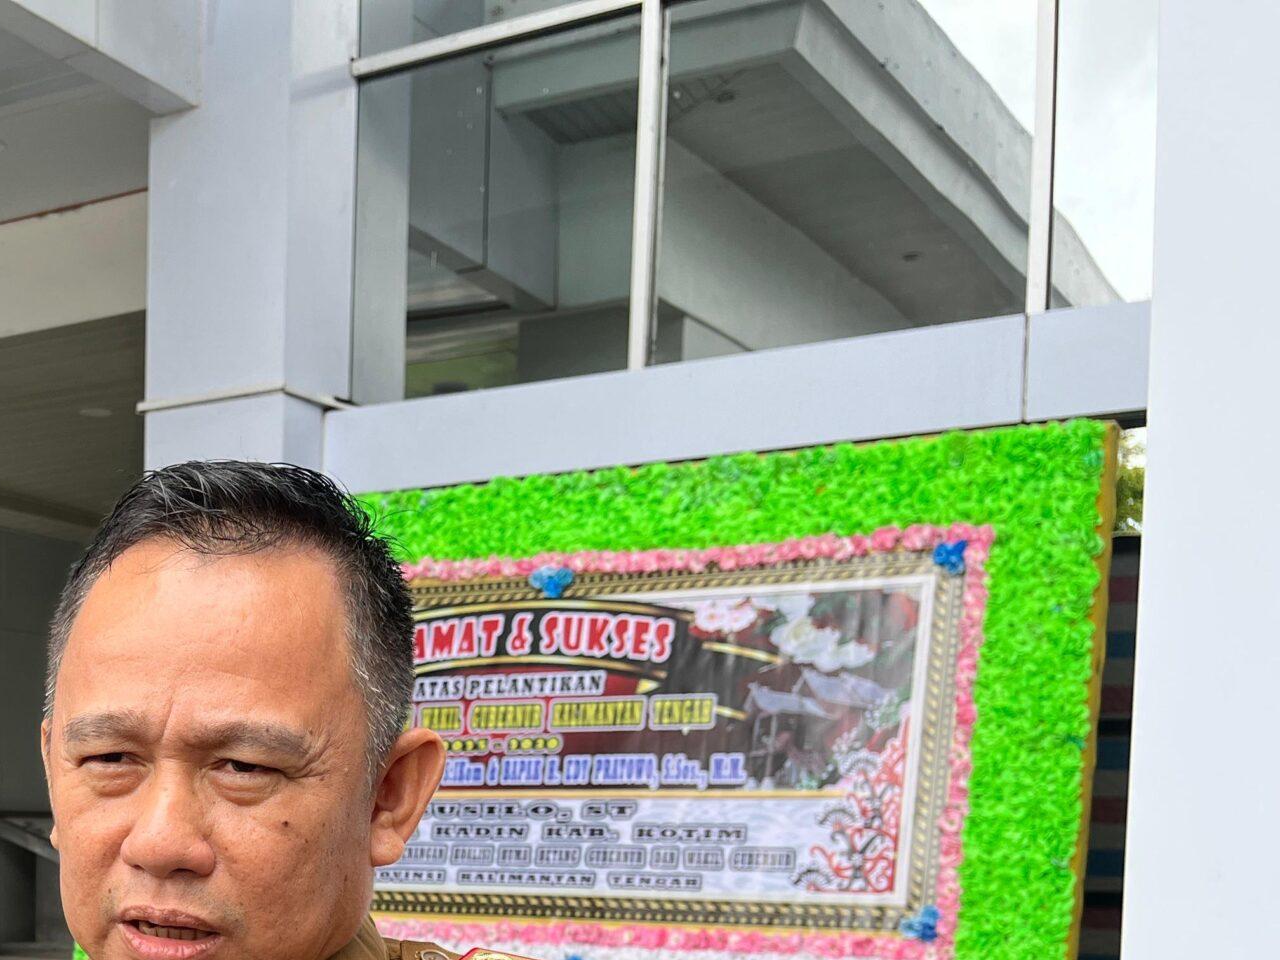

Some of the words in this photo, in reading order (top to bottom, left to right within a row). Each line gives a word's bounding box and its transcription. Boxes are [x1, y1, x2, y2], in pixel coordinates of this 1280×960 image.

[510, 616, 529, 651] &
[543, 616, 671, 659] SUKSES
[415, 680, 461, 698] ATAS
[469, 674, 602, 696] PELANTIKAN
[471, 704, 542, 729] GUBERNUR
[551, 700, 644, 727] KALIMANTAN
[654, 698, 713, 725] TENGAH
[425, 804, 569, 820] USILO,
[587, 804, 633, 816] ST
[435, 826, 525, 837] KADIN
[547, 826, 616, 839] KAB.
[637, 827, 742, 840] KOTIM
[375, 870, 443, 881] OVINSI
[461, 871, 592, 885] KALIMANTAN
[612, 874, 699, 887] TENGAH
